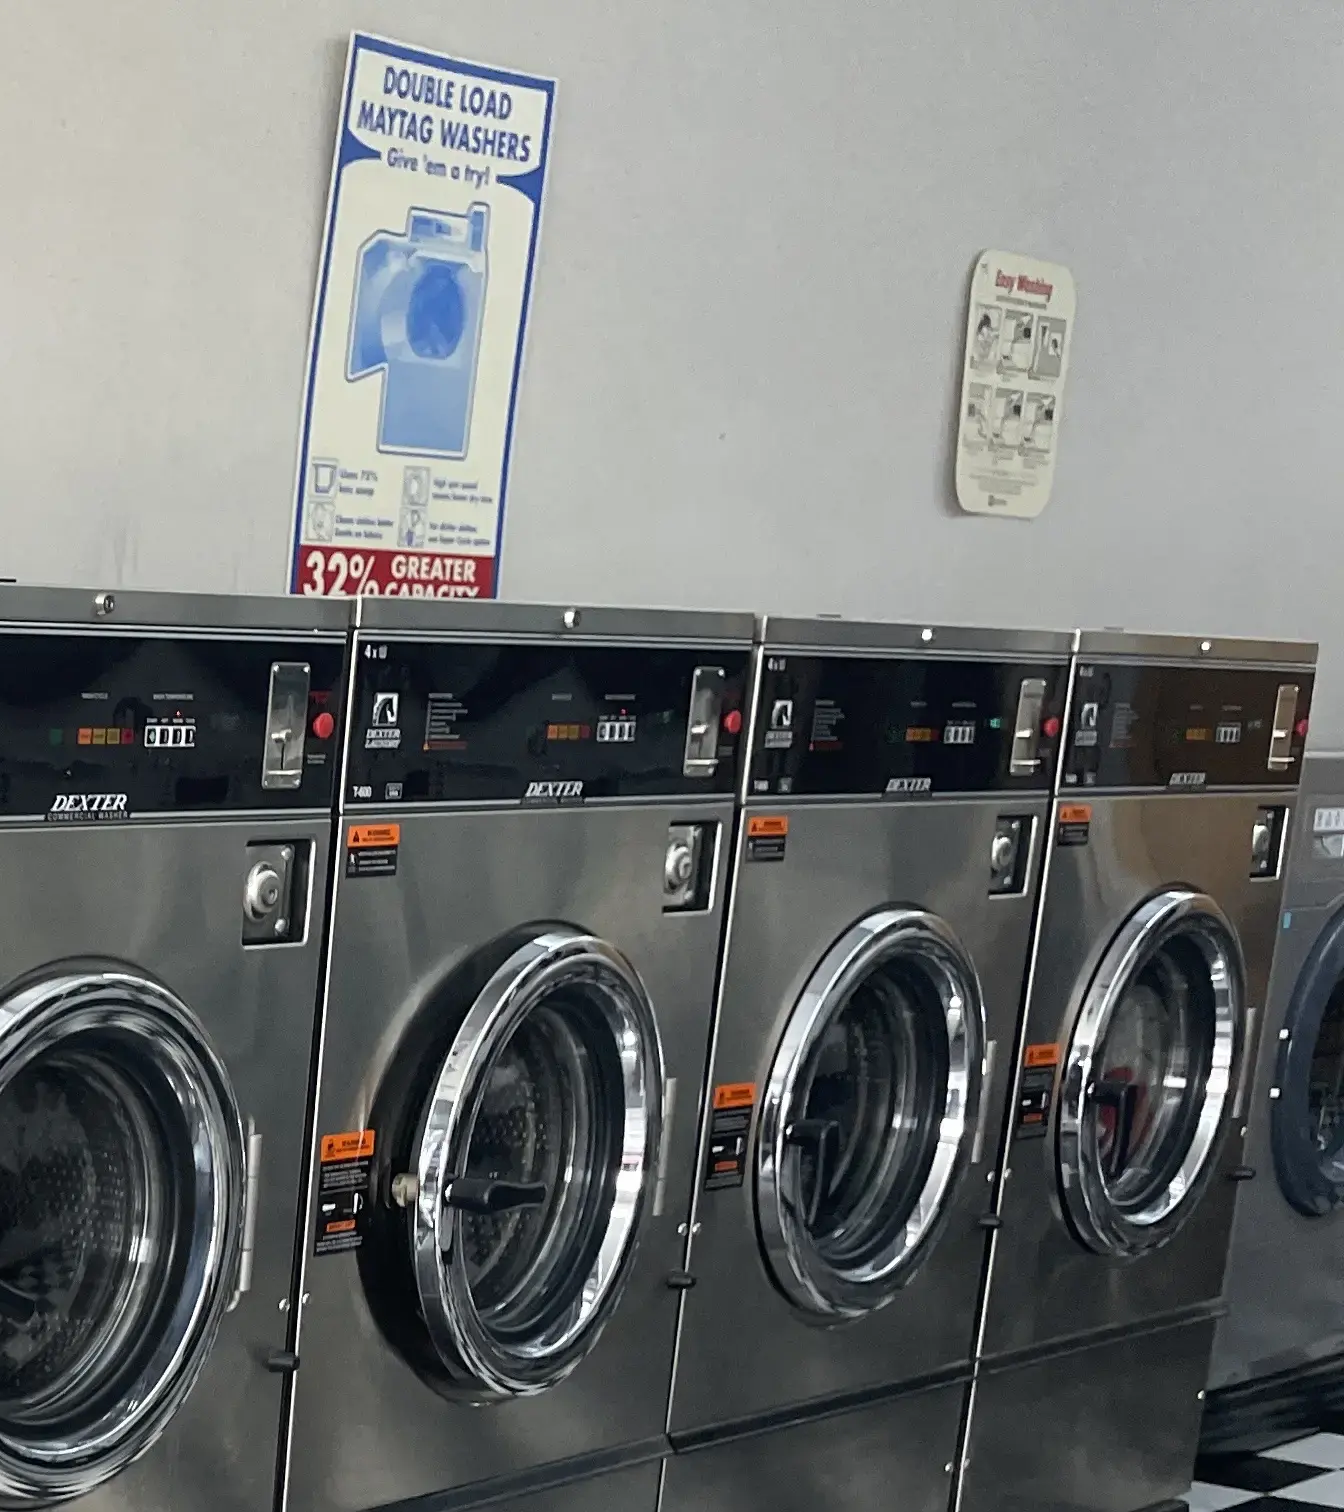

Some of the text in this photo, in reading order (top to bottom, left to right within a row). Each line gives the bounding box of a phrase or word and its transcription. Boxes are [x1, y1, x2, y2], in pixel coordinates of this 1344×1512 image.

[382, 66, 512, 120] DOUBLE LOAD
[357, 100, 532, 163] MAYTAG WASHERS
[386, 148, 491, 189] Give 'em a try!
[302, 550, 476, 597] 32% GREATER
[50, 794, 127, 812] DEXTER
[525, 781, 583, 797] DEXTER
